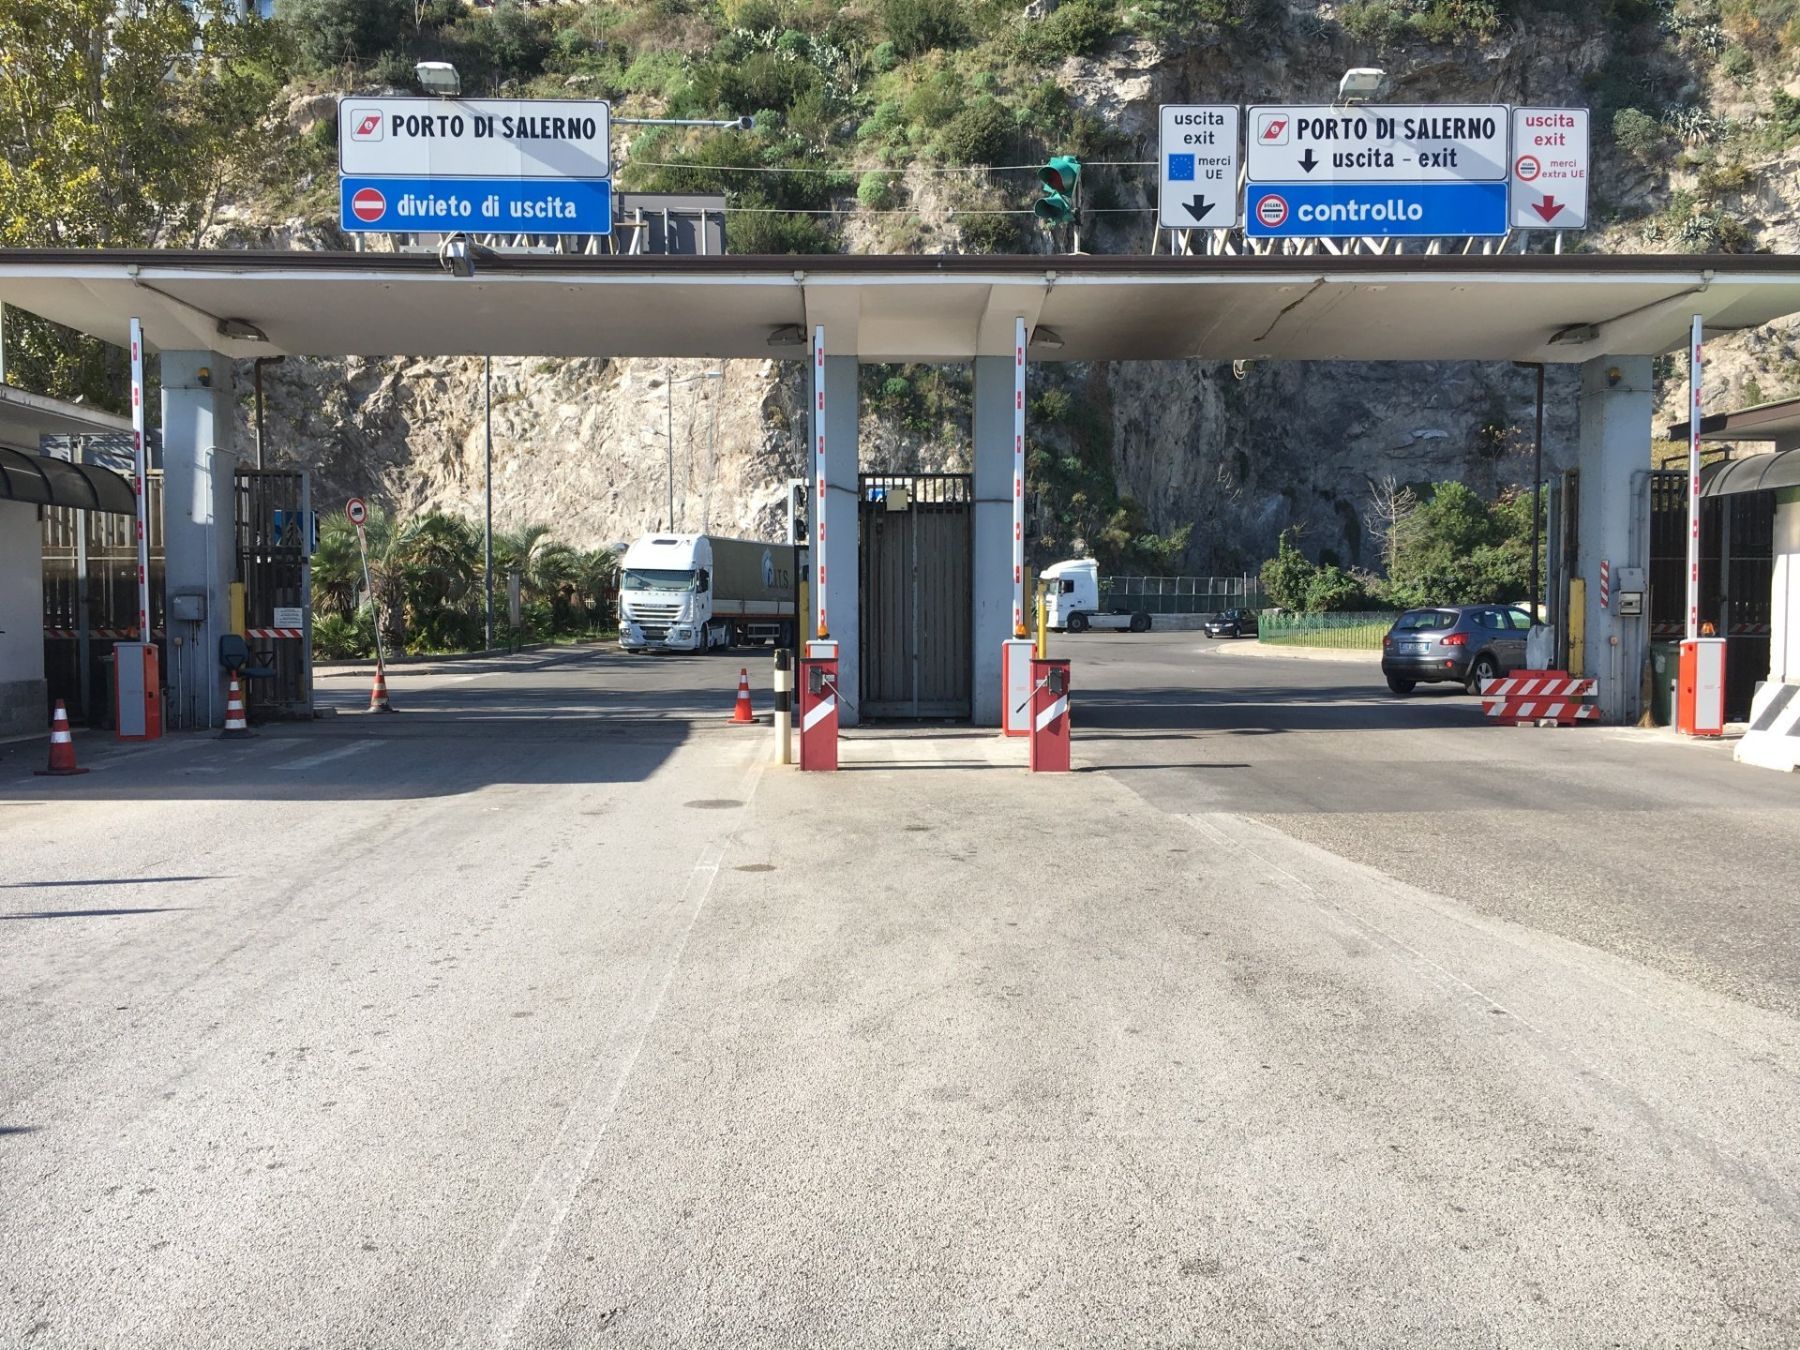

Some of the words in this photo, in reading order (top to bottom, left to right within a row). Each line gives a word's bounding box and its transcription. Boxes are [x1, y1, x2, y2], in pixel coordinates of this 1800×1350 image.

[1174, 112, 1224, 125] uscita
[1525, 114, 1575, 128] uscita
[392, 115, 464, 138] PORTO
[474, 116, 494, 138] DI
[502, 117, 596, 140] SALERNO
[1297, 118, 1368, 140] PORTO
[1376, 118, 1395, 140] DI
[1404, 117, 1496, 140] SALERNO
[1183, 131, 1215, 145] exit
[1534, 133, 1566, 146] exit
[1198, 155, 1231, 166] merci
[1332, 147, 1394, 168] uscita
[1418, 148, 1458, 168] exit
[1550, 159, 1577, 168] merci
[1206, 169, 1223, 180] UE
[1542, 170, 1567, 178] extra
[1570, 170, 1585, 178] UE
[397, 194, 471, 217] divieto
[481, 195, 499, 217] di
[510, 198, 576, 218] uscita
[1298, 199, 1423, 221] controllo
